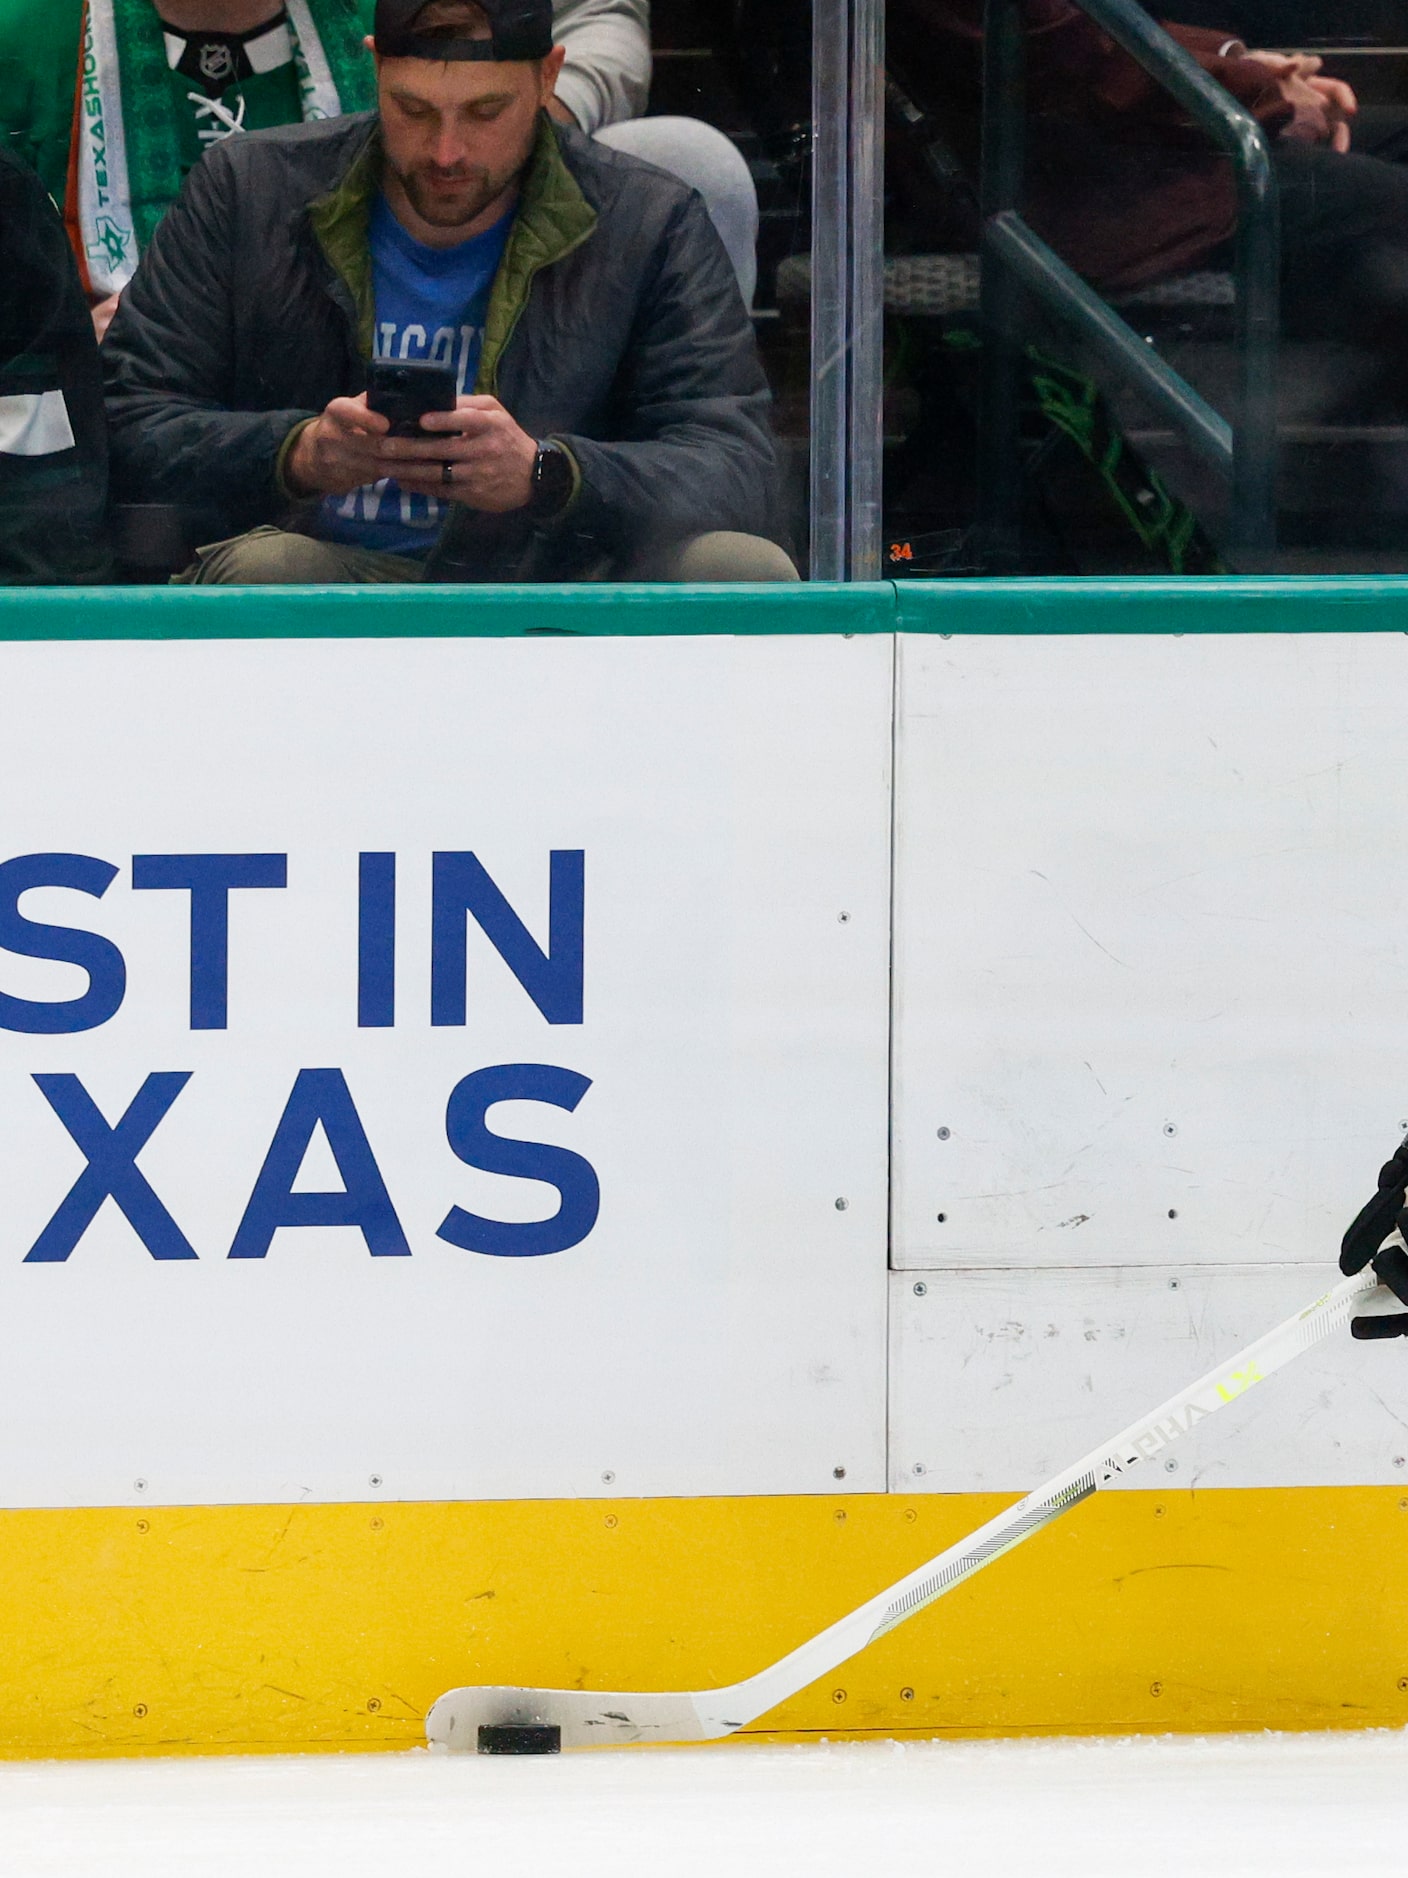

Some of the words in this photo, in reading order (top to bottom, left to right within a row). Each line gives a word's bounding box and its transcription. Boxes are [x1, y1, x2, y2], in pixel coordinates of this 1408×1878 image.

[889, 542, 913, 561] 34
[0, 852, 288, 1034] ST
[357, 849, 586, 1028] IN
[22, 1063, 601, 1264] XAS
[1098, 1402, 1213, 1488] ALPHA
[1215, 1360, 1265, 1404] LX
